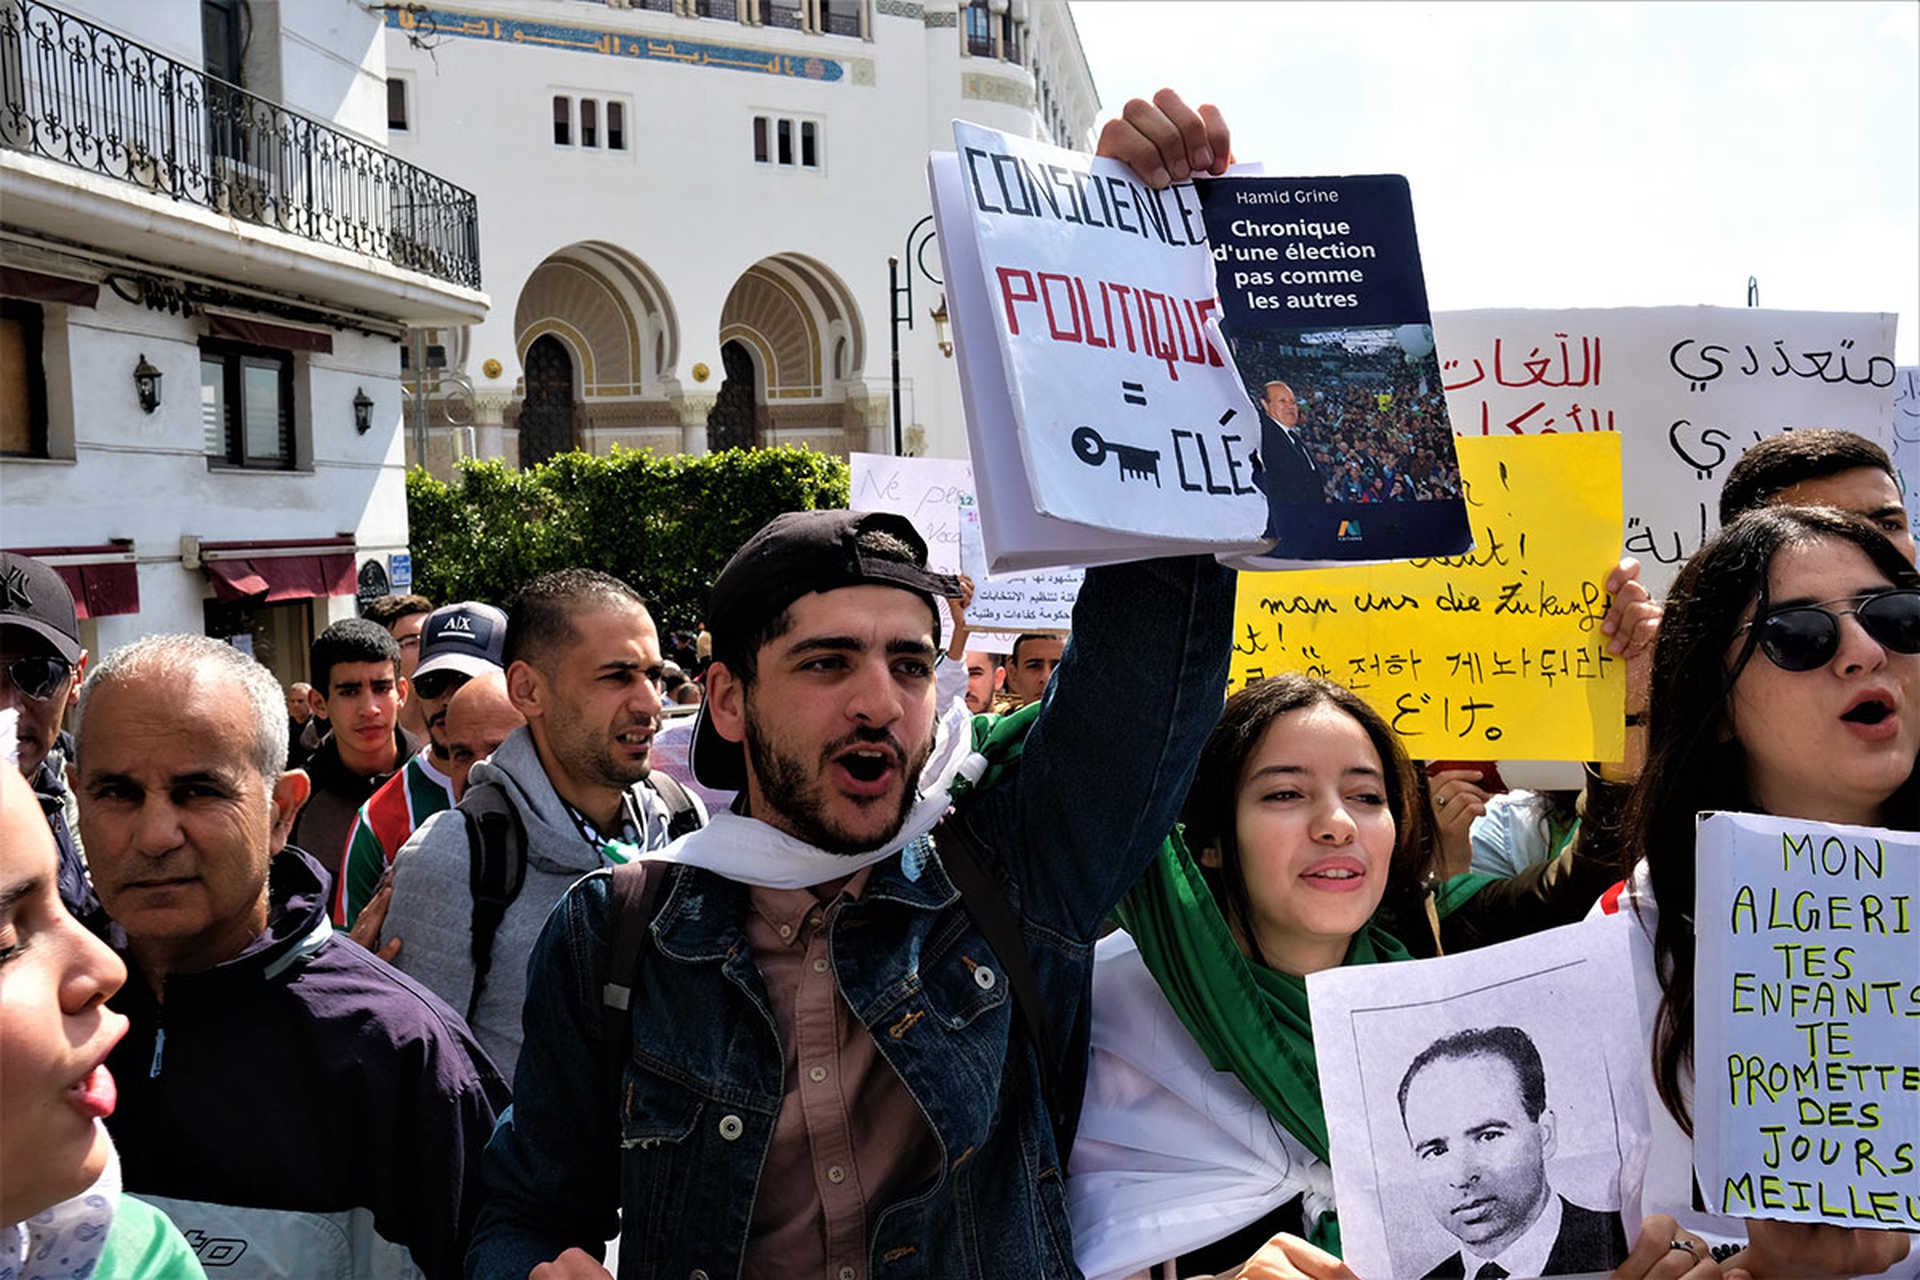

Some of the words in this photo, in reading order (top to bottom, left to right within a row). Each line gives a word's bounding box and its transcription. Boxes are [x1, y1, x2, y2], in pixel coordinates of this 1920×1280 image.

[965, 146, 1208, 247] CONSCIENCE
[1236, 190, 1290, 204] Hamid
[1294, 189, 1339, 203] Grine
[1231, 219, 1350, 239] Chronique
[1213, 244, 1278, 261] d'une
[1285, 242, 1375, 260] élection
[1234, 271, 1274, 289] pas
[1280, 269, 1363, 284] comme
[1247, 291, 1280, 309] les
[1286, 293, 1358, 309] autres
[1171, 408, 1257, 496] CLÉ
[1260, 596, 1338, 615] man
[1354, 593, 1419, 612] uns
[1436, 582, 1481, 613] die
[1782, 832, 1885, 880] MON
[1731, 885, 1910, 936] ALGERI
[1773, 945, 1856, 979] TES
[1732, 973, 1920, 1017] ENFANTS
[1795, 1021, 1854, 1058] TE
[1798, 1098, 1883, 1127] DES
[1759, 1126, 1915, 1177] JOURS
